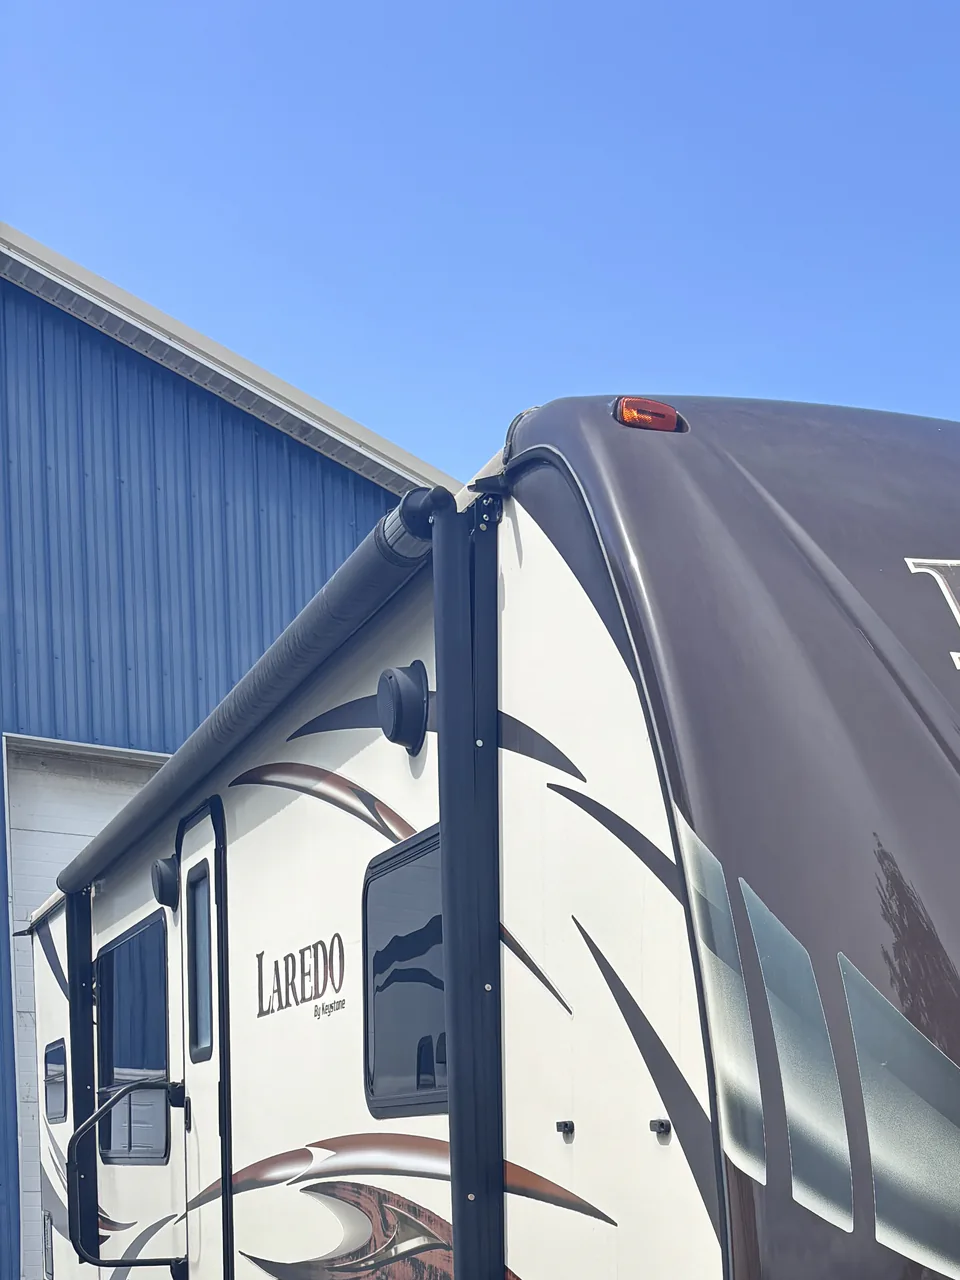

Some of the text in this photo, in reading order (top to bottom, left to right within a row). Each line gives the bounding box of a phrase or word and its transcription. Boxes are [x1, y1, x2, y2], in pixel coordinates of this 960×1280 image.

[255, 932, 345, 1019] LAREDO
[313, 998, 346, 1020] By Keystone
